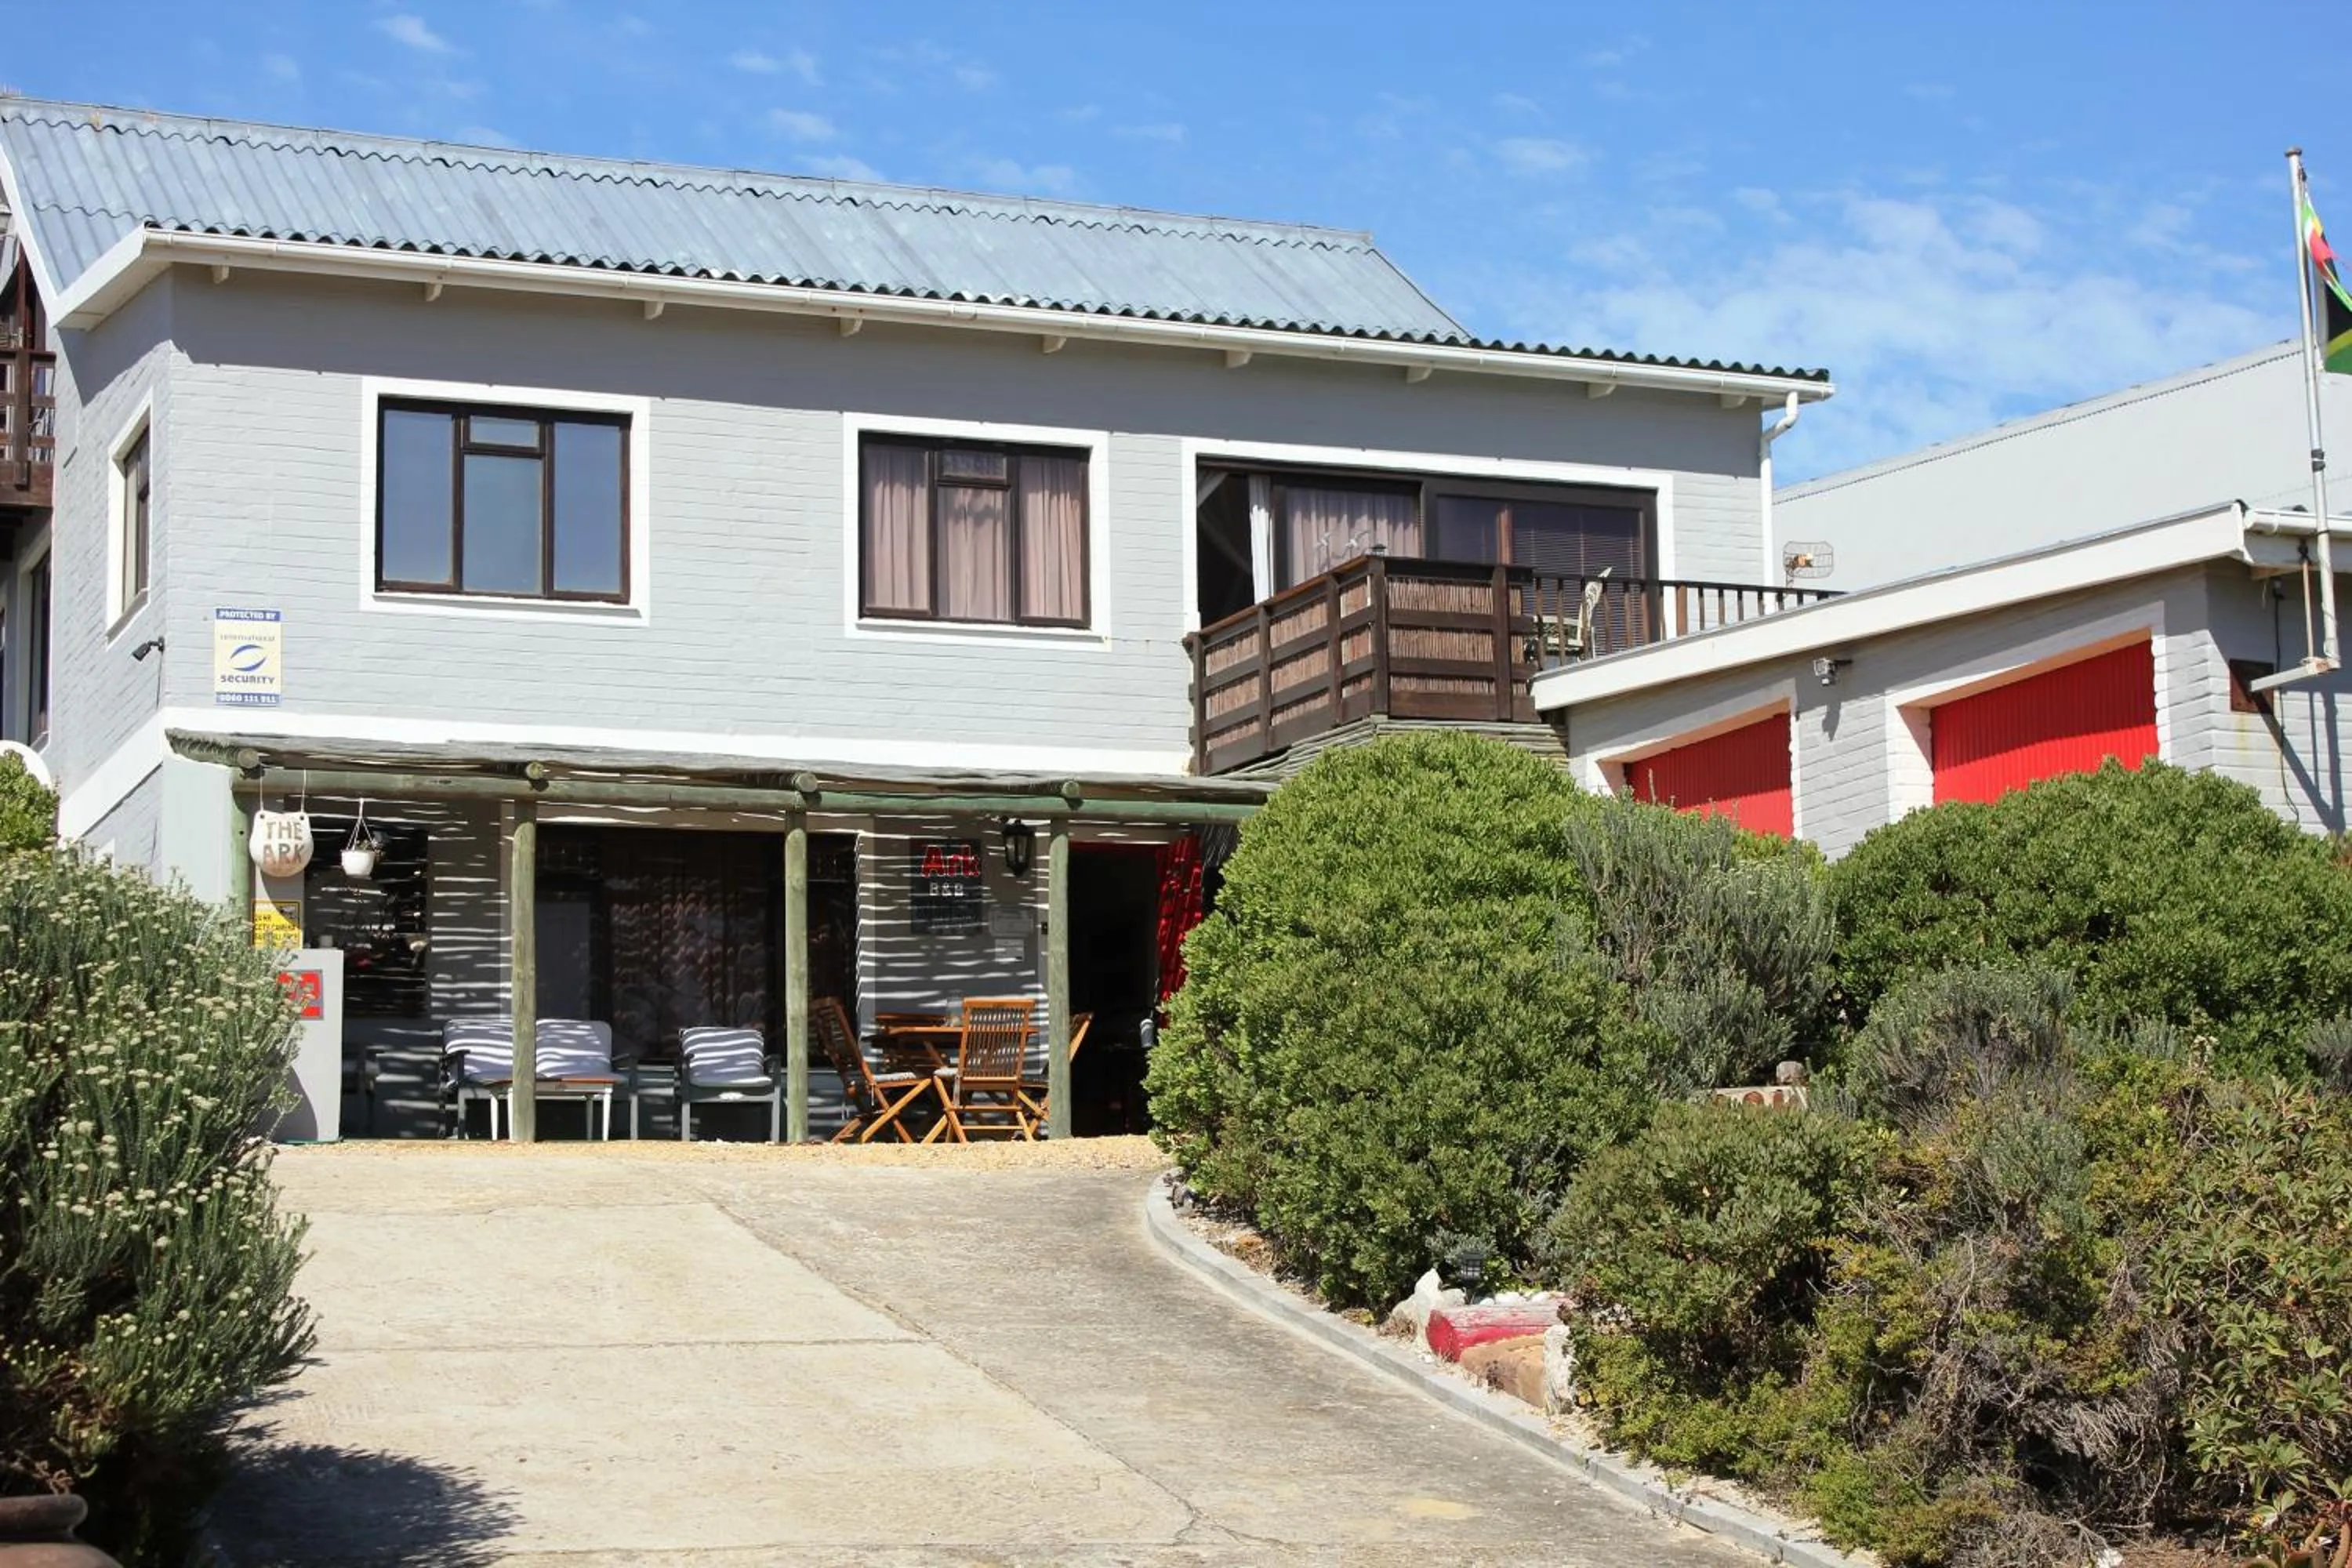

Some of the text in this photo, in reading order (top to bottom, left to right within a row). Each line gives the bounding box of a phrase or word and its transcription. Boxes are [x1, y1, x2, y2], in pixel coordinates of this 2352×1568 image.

[220, 610, 277, 620] PROTECTED BY
[267, 821, 303, 840] THE
[263, 843, 304, 865] ARK
[921, 844, 980, 878] Ark
